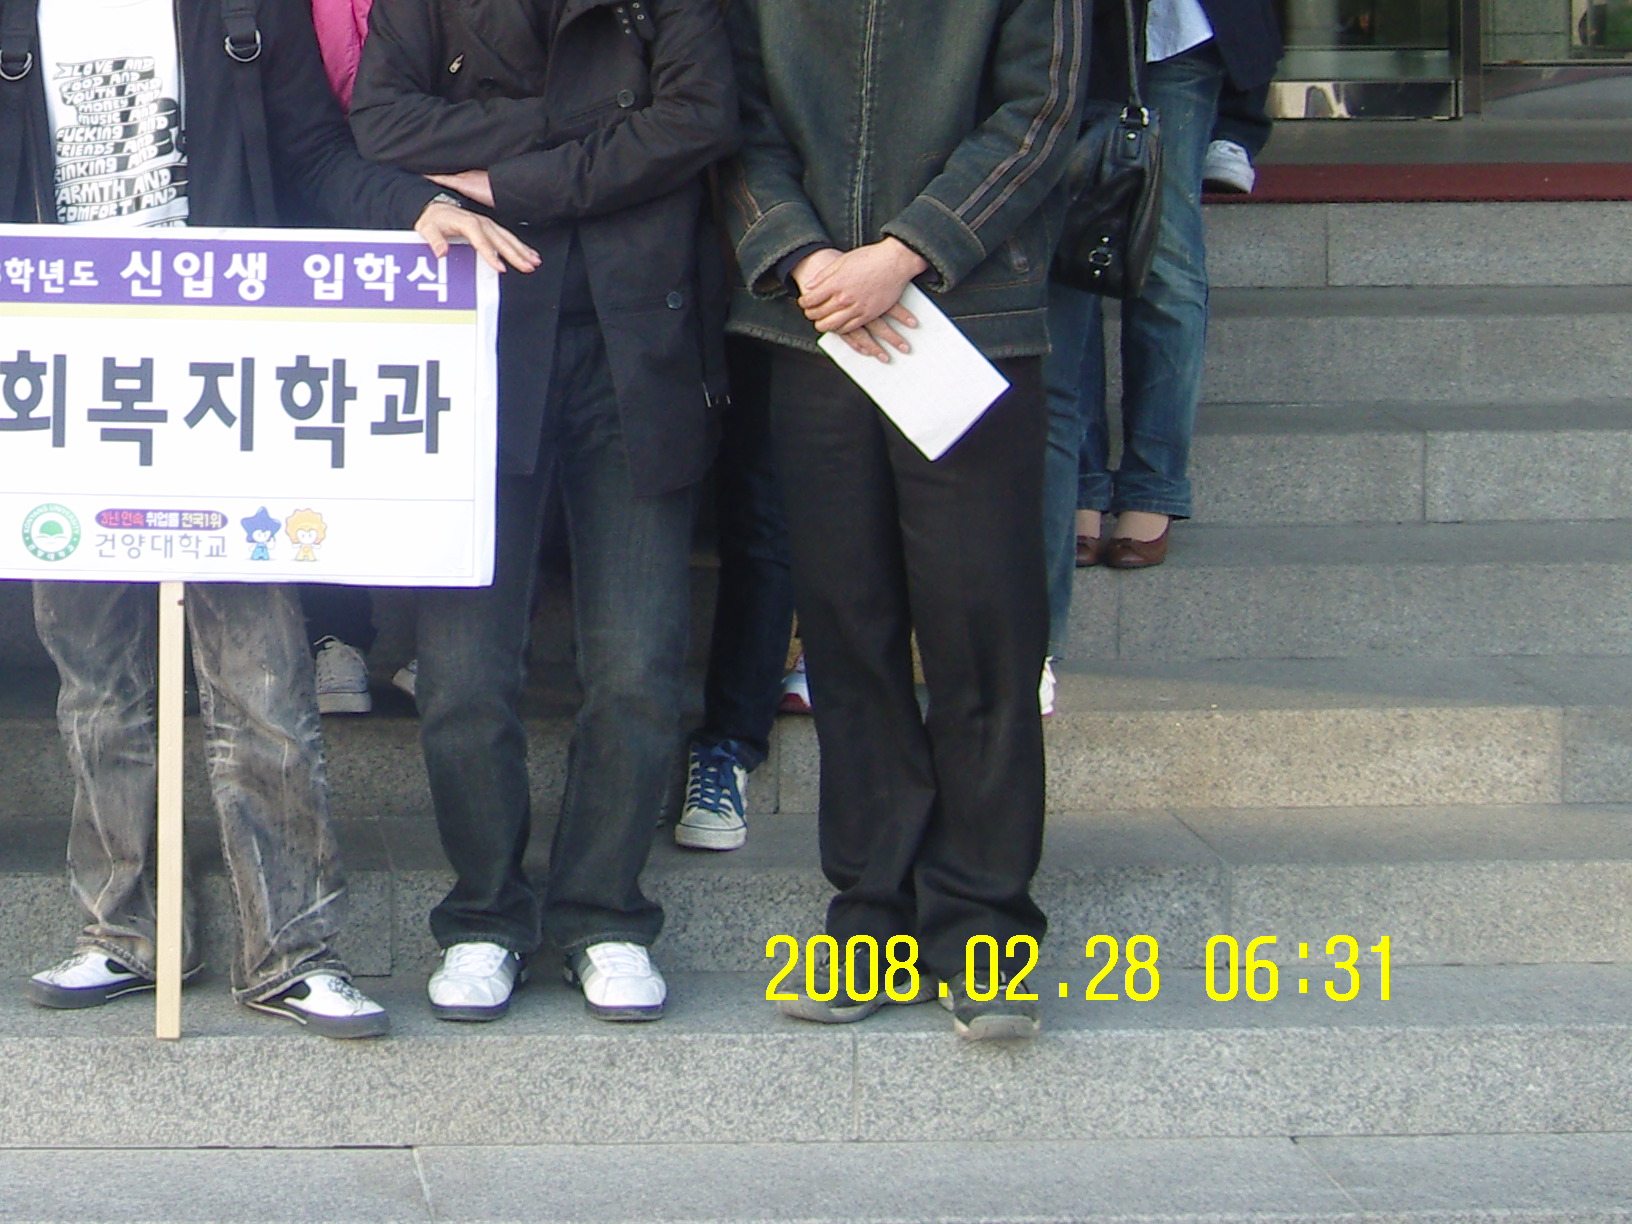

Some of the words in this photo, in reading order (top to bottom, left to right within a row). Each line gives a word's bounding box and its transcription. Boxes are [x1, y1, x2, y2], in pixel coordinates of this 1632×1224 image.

[73, 60, 113, 76] LOVE
[63, 87, 117, 105] YOUTH
[55, 157, 117, 182] RINKING
[55, 178, 126, 206] ARMTH
[133, 168, 171, 195] AND
[119, 250, 268, 301] 신입생
[303, 252, 449, 303] 입학식
[94, 533, 228, 560] 건양대학교
